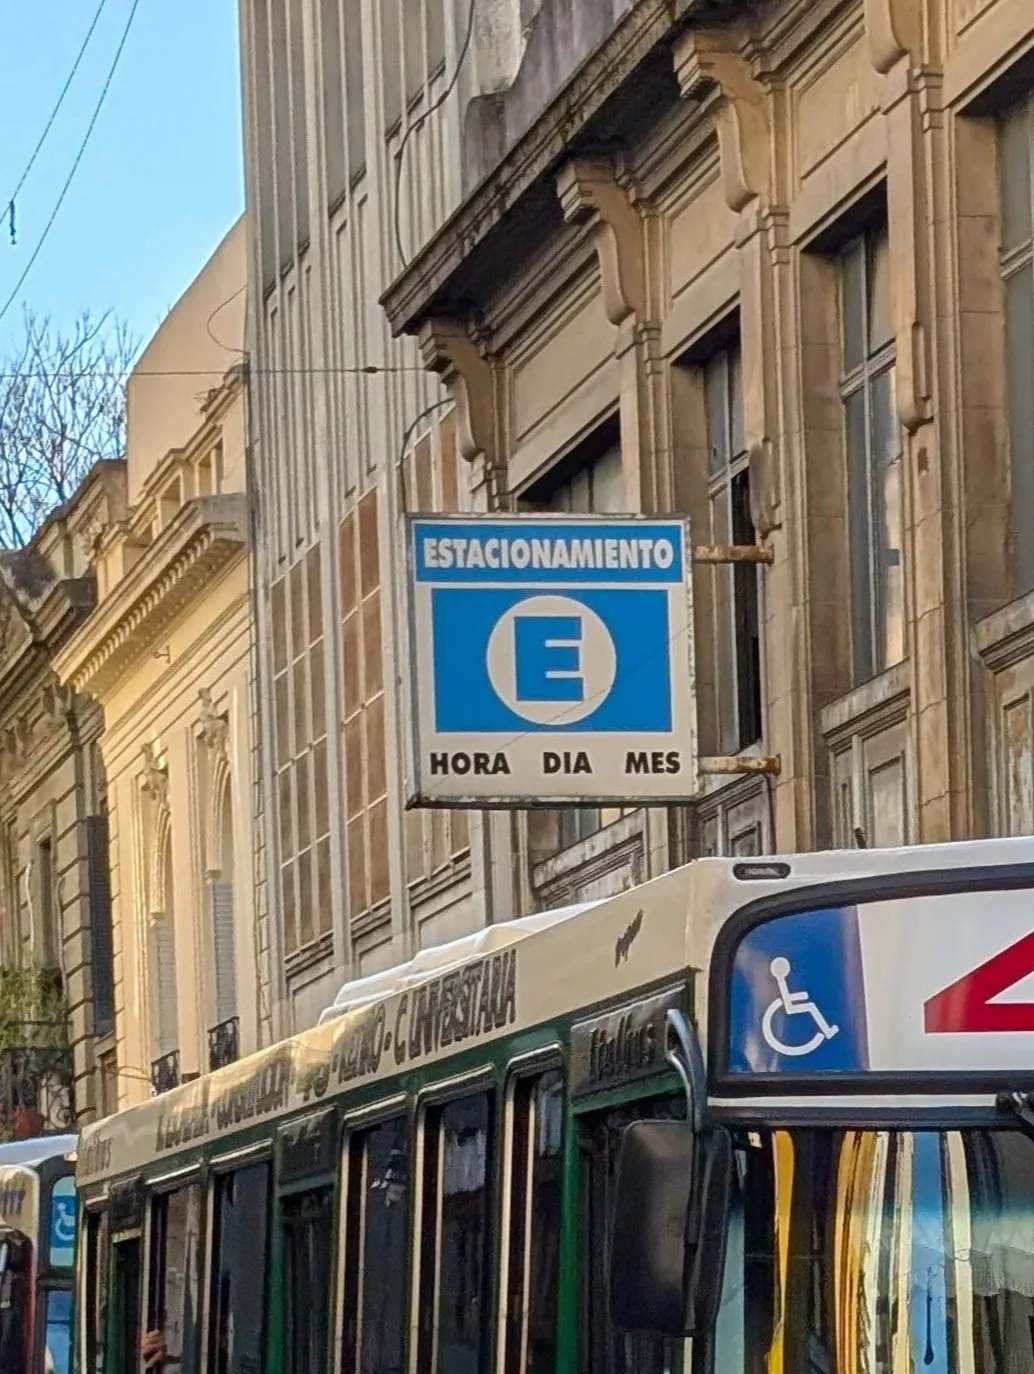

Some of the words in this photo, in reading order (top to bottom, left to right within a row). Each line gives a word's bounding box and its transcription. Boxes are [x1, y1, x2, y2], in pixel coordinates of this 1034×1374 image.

[423, 538, 673, 569] ESTACIONAMIENTO
[514, 616, 584, 701] E
[430, 752, 511, 775] HORA
[543, 752, 592, 774] DIA
[625, 752, 681, 774] MES
